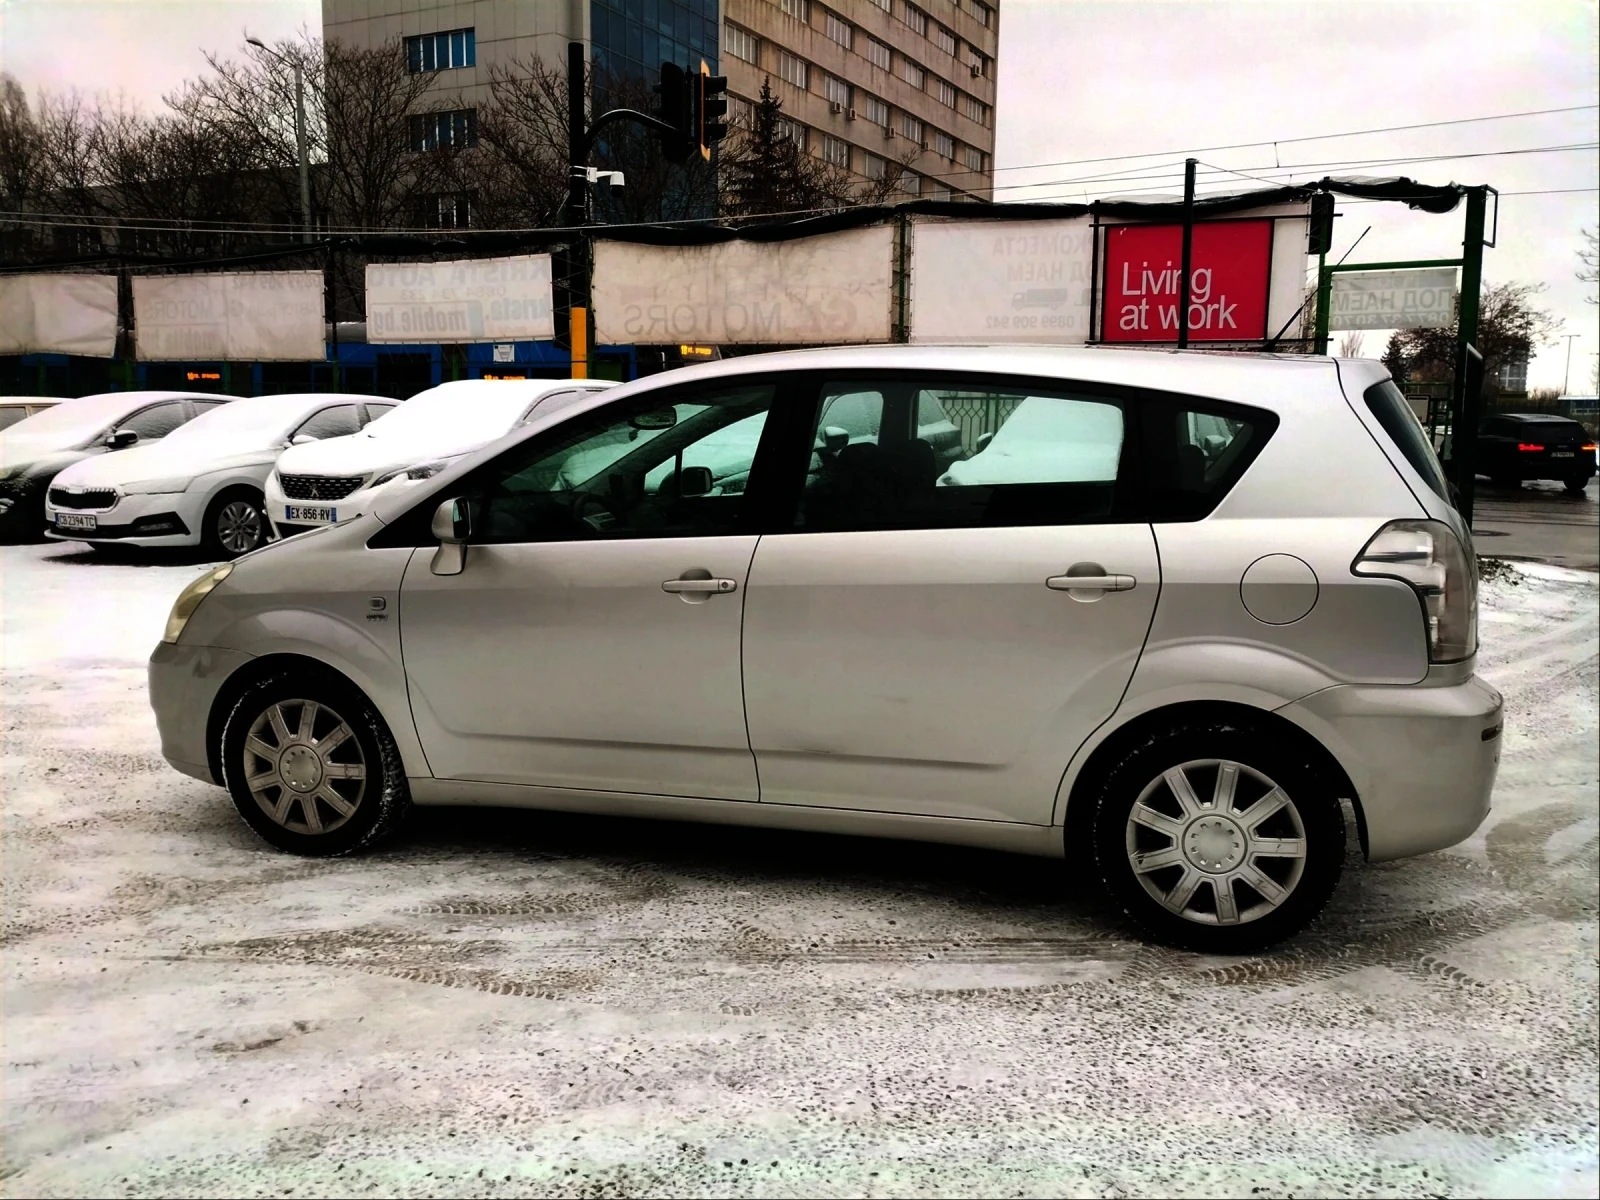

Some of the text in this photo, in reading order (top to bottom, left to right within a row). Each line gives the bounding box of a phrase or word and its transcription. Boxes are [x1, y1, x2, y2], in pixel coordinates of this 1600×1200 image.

[1122, 261, 1212, 303] Living
[1119, 295, 1238, 330] at work
[59, 514, 68, 526] CB
[84, 516, 95, 527] TC
[291, 507, 330, 521] EX-856-RV
